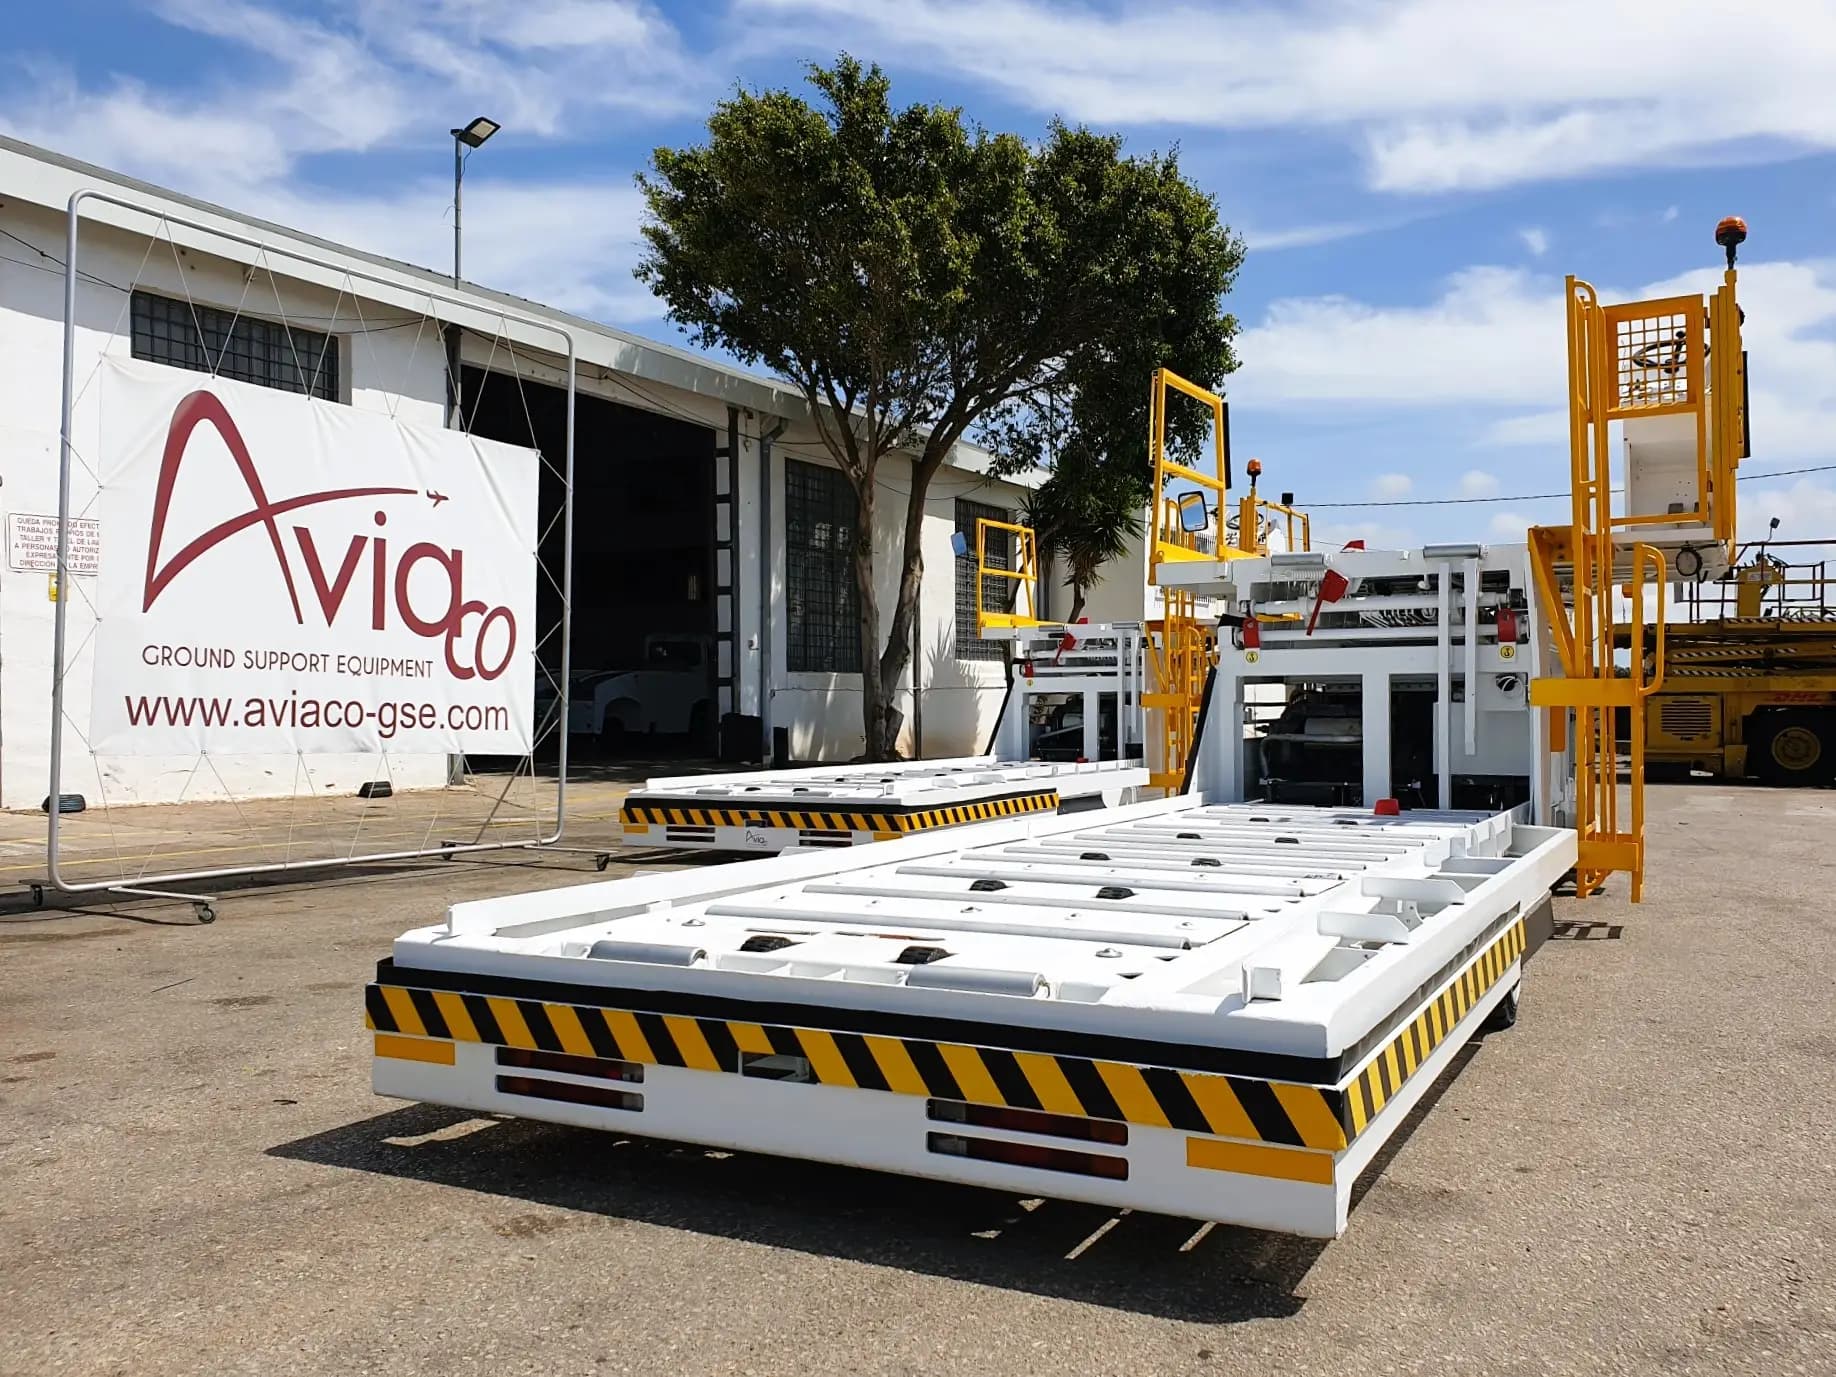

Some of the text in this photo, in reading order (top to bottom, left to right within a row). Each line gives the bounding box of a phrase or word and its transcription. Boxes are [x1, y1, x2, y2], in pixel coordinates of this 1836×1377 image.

[17, 517, 40, 526] QUEDA
[43, 519, 77, 529] PRODO
[16, 525, 53, 535] TRABAJOS
[56, 529, 84, 537] PPIOS
[20, 534, 44, 542] TALLER
[22, 543, 59, 551] PERSONAS
[142, 644, 434, 678] GROUND SUPPORT EQUIPMENT
[124, 689, 509, 739] www.aviaco-gse.com
